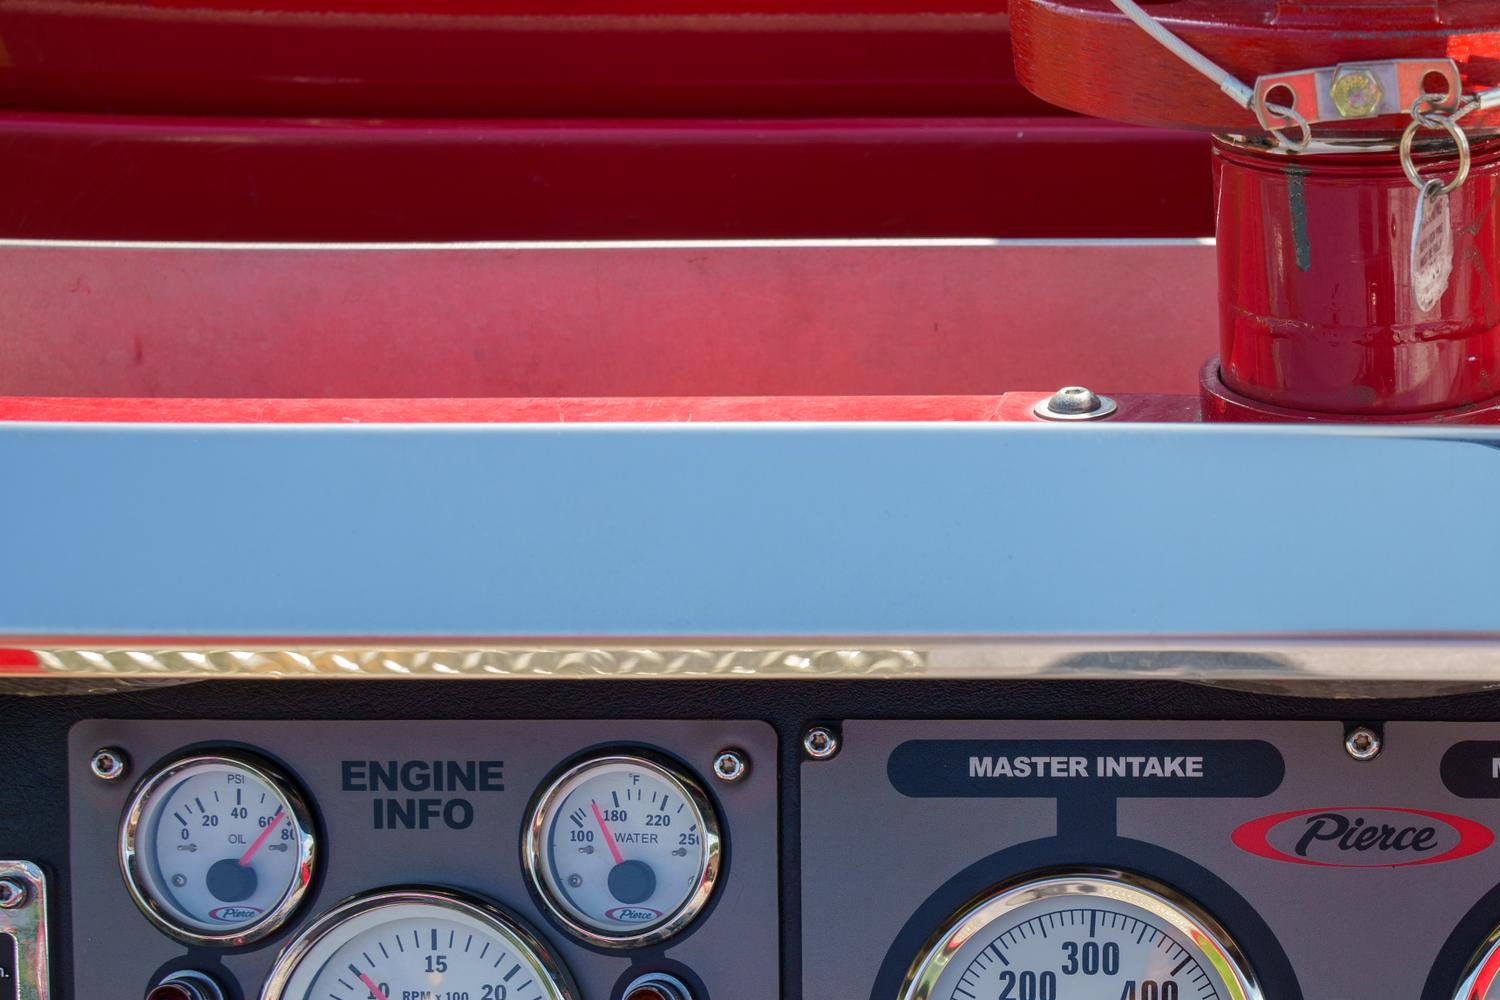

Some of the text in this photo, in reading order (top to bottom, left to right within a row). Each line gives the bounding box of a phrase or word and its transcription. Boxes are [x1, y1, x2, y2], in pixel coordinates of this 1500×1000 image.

[227, 774, 245, 784] PSI
[341, 760, 505, 791] ENGINE
[968, 756, 1204, 778] MASTER INTAKE
[181, 828, 190, 840] 0
[202, 815, 218, 827] 20
[230, 807, 247, 819] 40
[373, 798, 473, 829] INFO
[570, 830, 594, 842] 100
[603, 809, 627, 822] 180
[645, 814, 670, 827] 220
[228, 834, 246, 844] OIL
[614, 833, 658, 844] WATER
[1294, 812, 1438, 857] Pierce
[619, 908, 652, 920] Pierce
[1061, 941, 1120, 976] 300
[367, 982, 389, 1000] 10
[424, 955, 448, 973] 15
